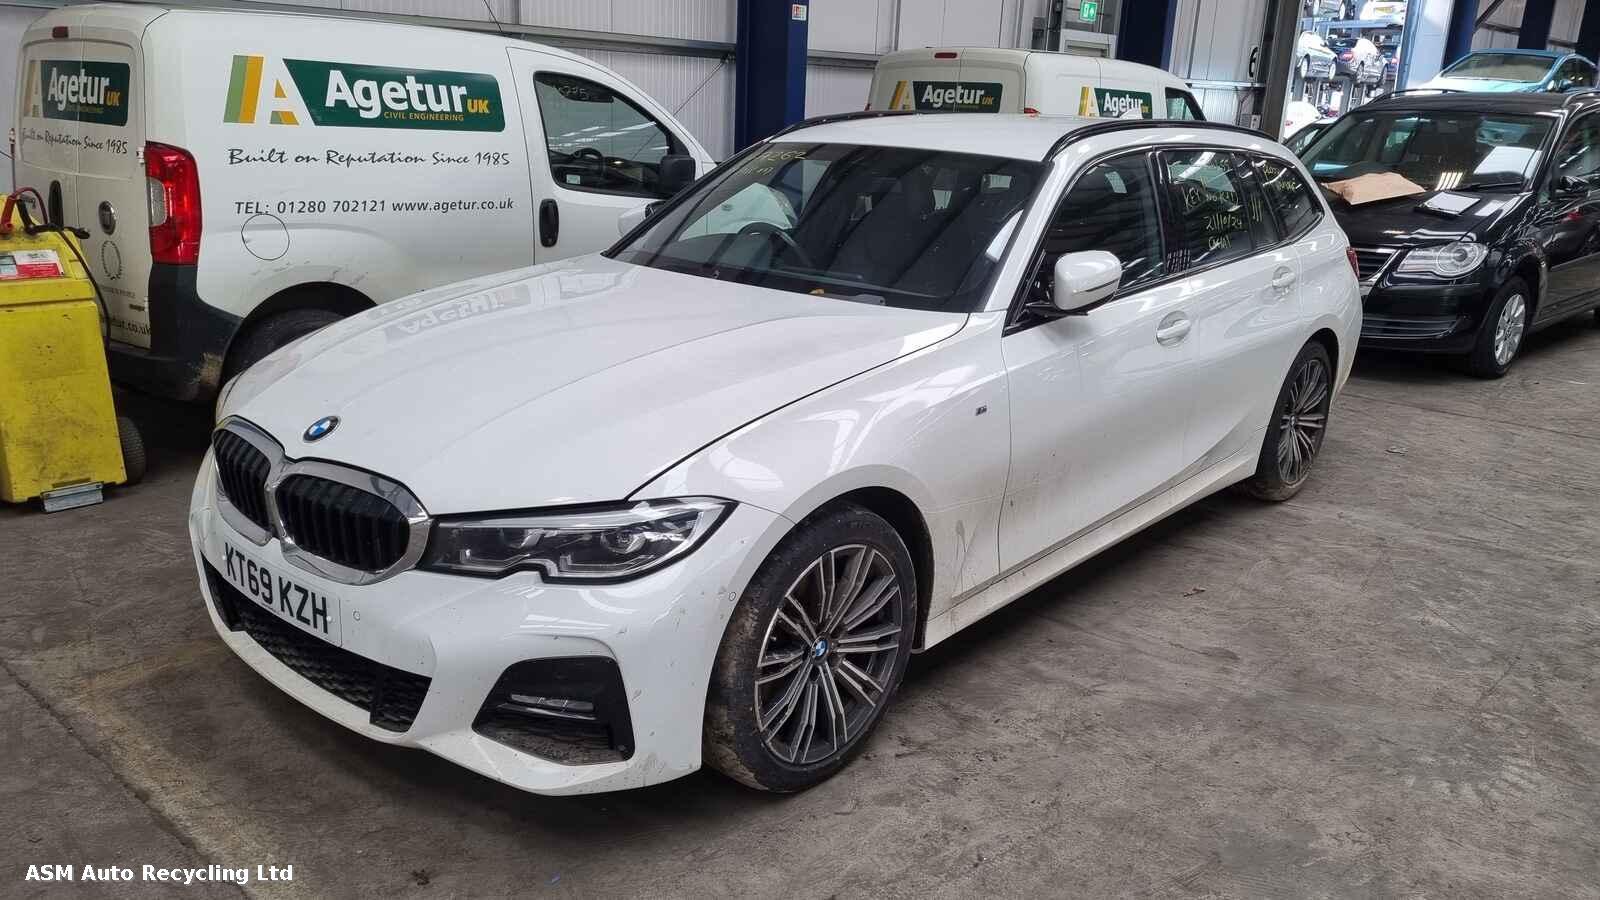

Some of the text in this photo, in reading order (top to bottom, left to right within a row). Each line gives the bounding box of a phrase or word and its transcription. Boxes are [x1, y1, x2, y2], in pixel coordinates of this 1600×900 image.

[47, 67, 110, 111] Agetur
[325, 69, 489, 119] Agetur UK
[921, 84, 985, 109] Agetur
[384, 111, 465, 122] CIVIL ENGINEERING
[1103, 91, 1143, 117] Agetur
[83, 136, 104, 149] Since
[106, 139, 128, 154] 1985
[228, 148, 511, 168] Built on Reputation Since 1985
[235, 197, 514, 214] TEL: 01280 702121 www.agetur.co.uk
[224, 542, 329, 635] KT69 KZH
